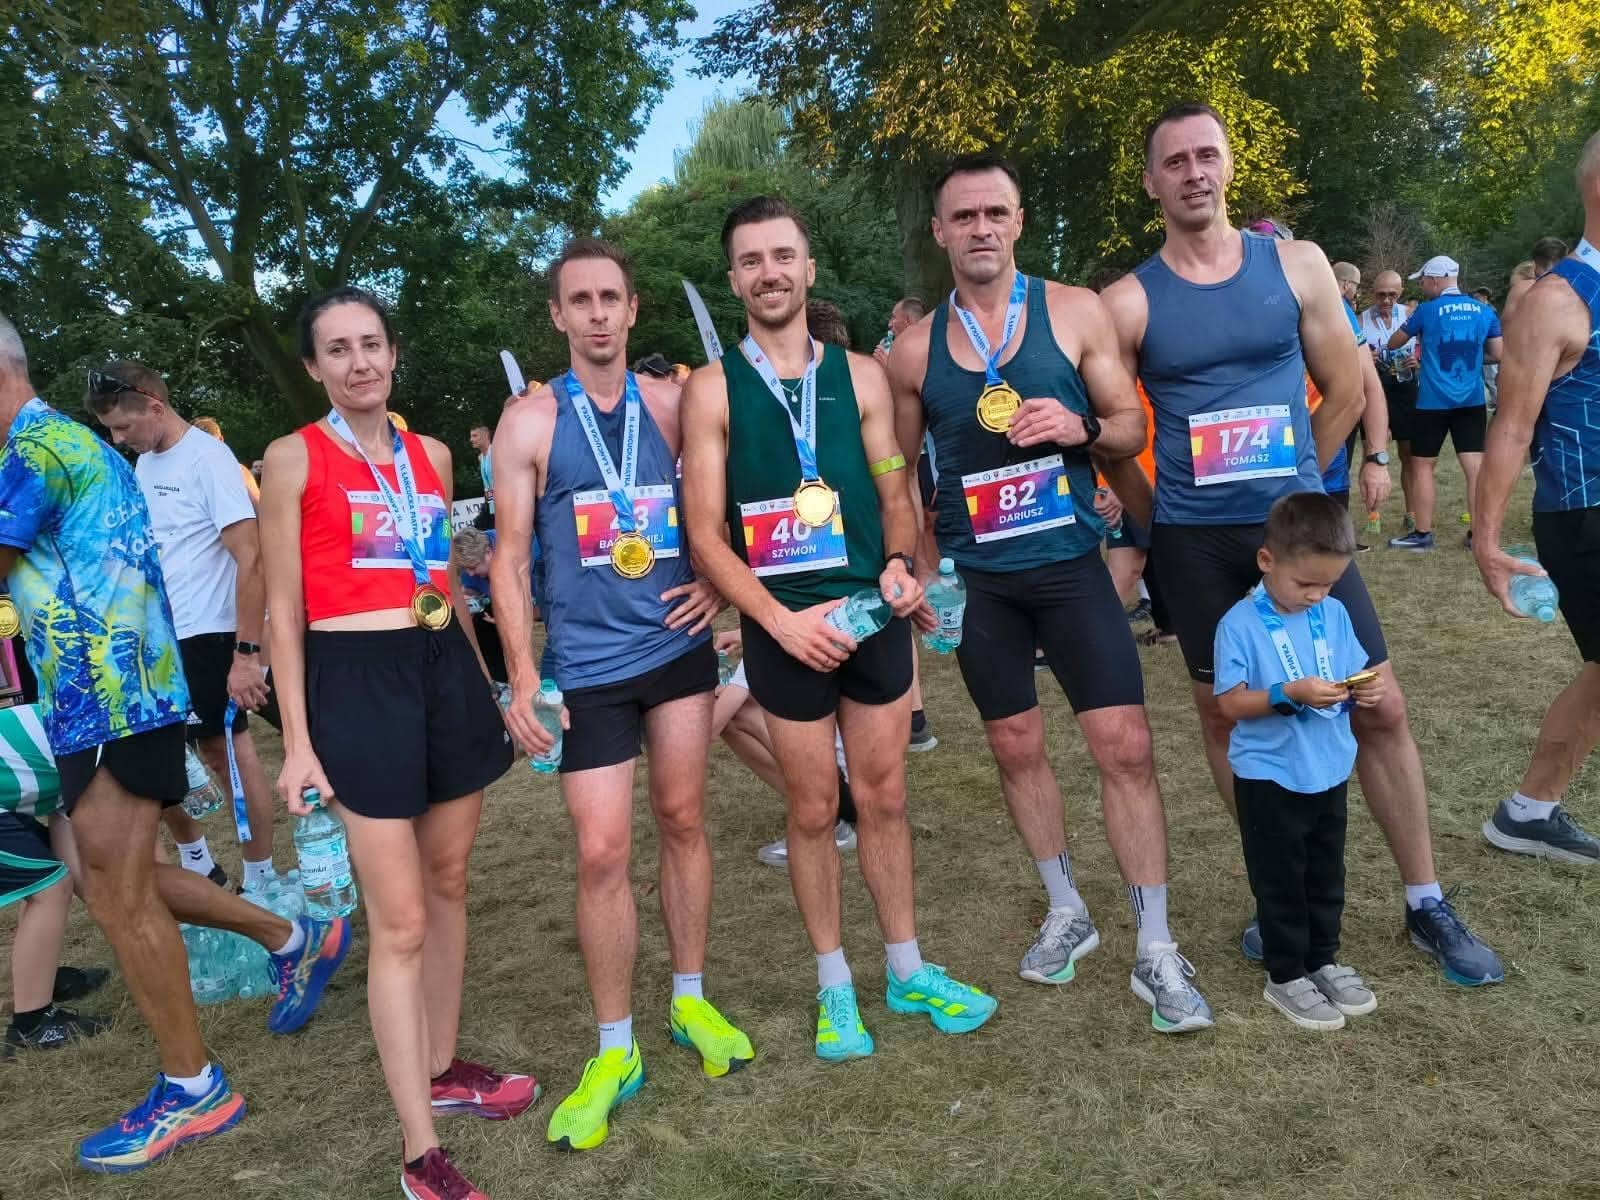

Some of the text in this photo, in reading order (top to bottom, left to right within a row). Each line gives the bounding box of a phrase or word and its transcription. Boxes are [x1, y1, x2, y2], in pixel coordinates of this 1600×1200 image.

[1219, 425, 1270, 454] 174
[1224, 454, 1270, 467] TOMASZ
[999, 480, 1037, 511] 82
[999, 507, 1044, 524] DARIUSZ
[770, 517, 812, 544] 40
[771, 545, 817, 558] SZYMON
